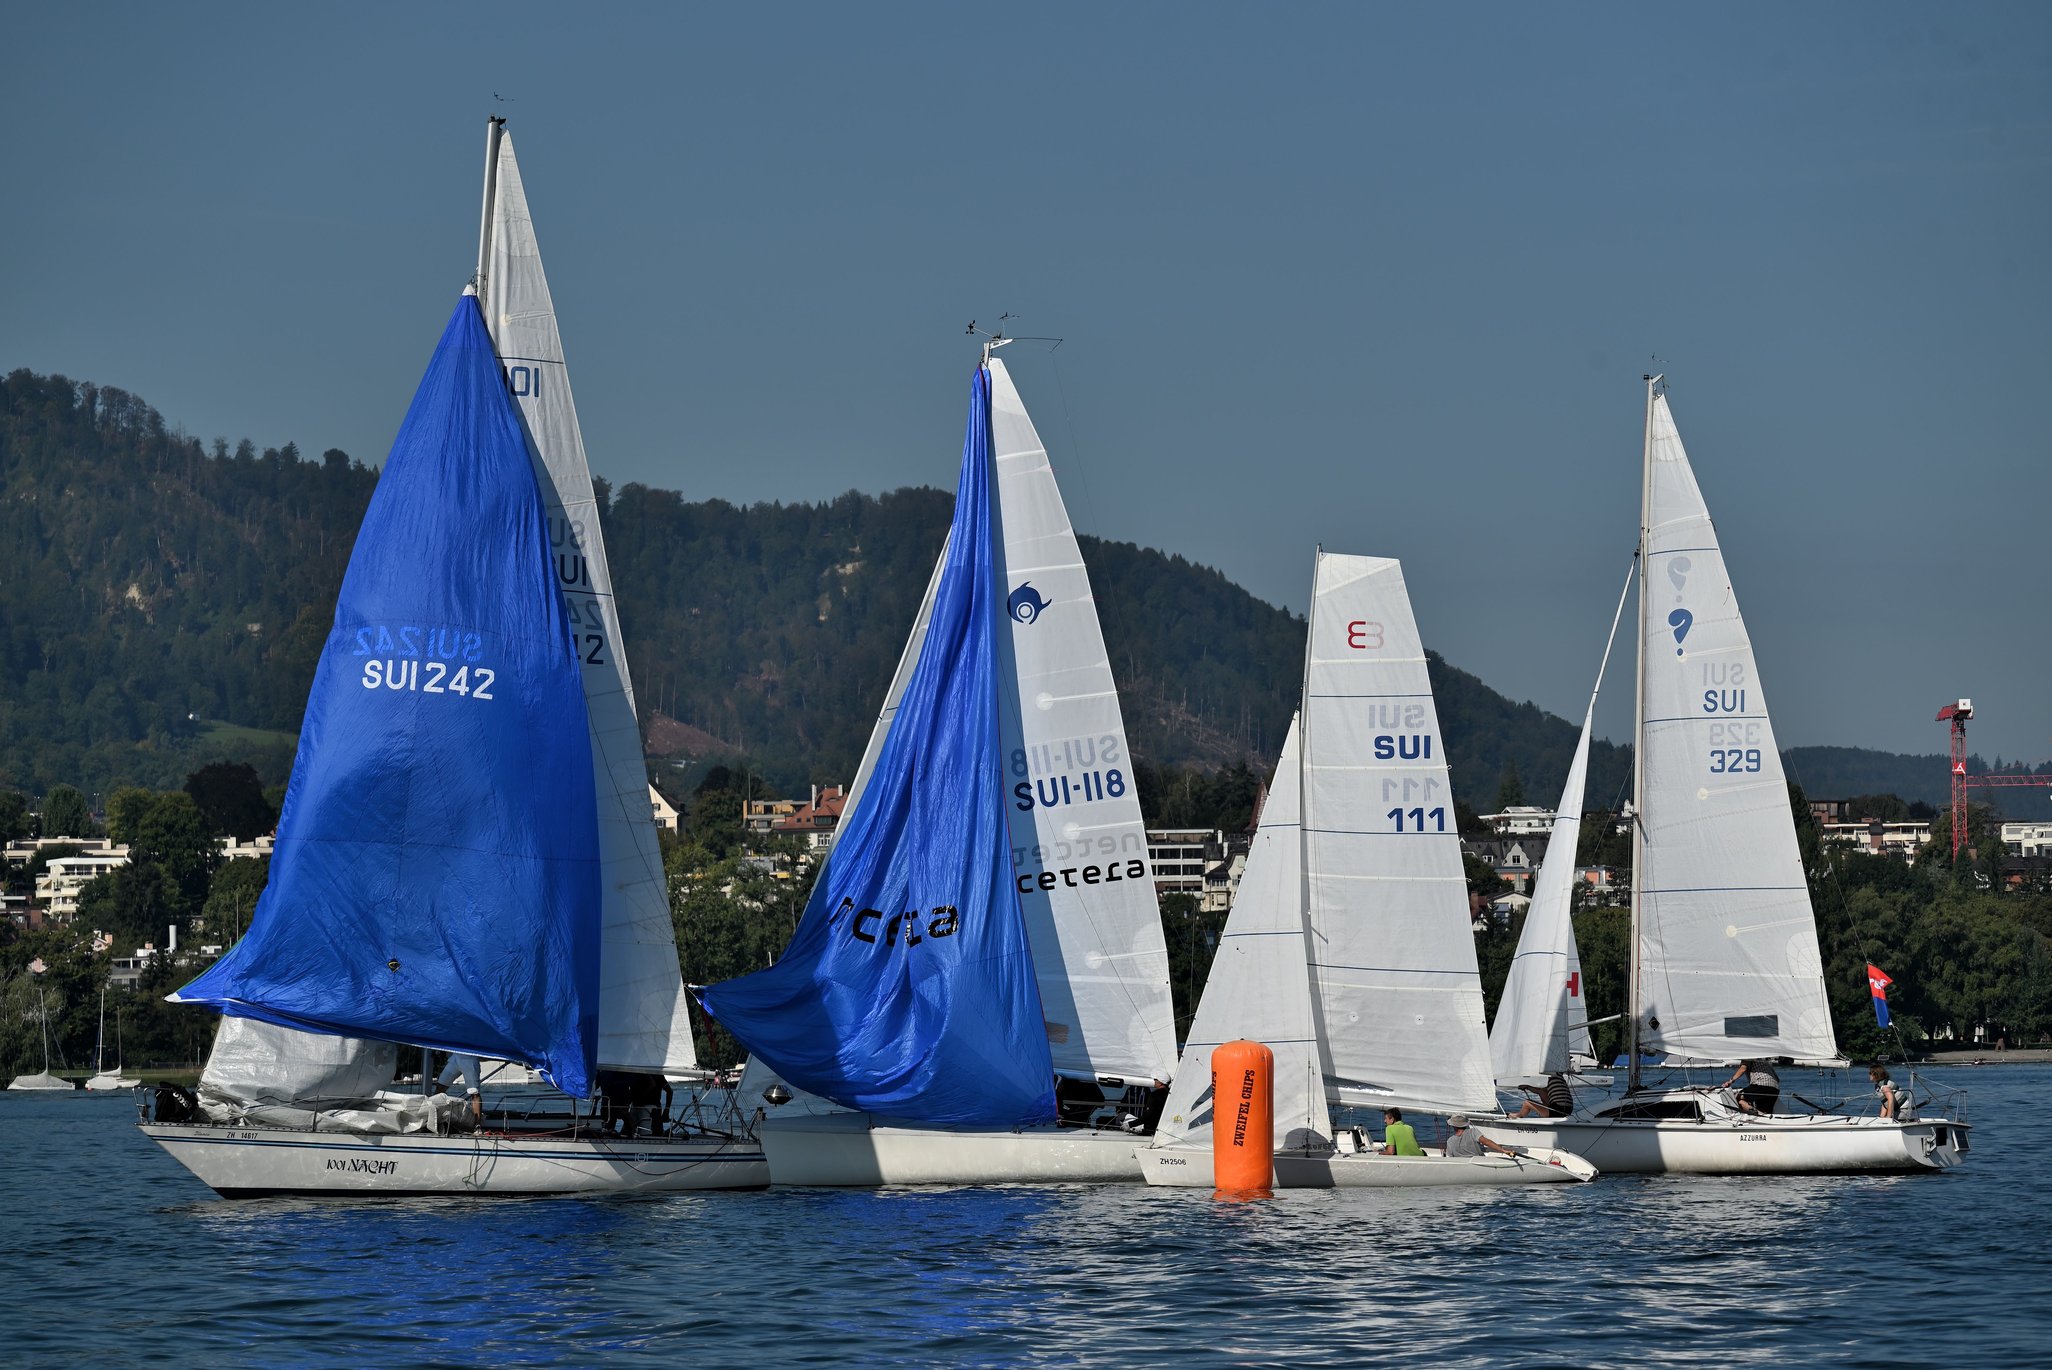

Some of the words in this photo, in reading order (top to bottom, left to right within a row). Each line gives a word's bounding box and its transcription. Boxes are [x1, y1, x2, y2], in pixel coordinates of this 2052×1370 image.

[553, 553, 587, 586] UI
[362, 659, 418, 691] SUI
[423, 662, 495, 700] 242
[1702, 689, 1745, 713] SUI
[1374, 735, 1431, 760] SUI
[1709, 749, 1761, 773] 329
[1014, 769, 1126, 812] SUI-118
[1387, 807, 1445, 832] 111
[1241, 1069, 1255, 1099] CHIPS
[1233, 1102, 1250, 1147] ZWEIFEL
[347, 1158, 399, 1175] NACHT
